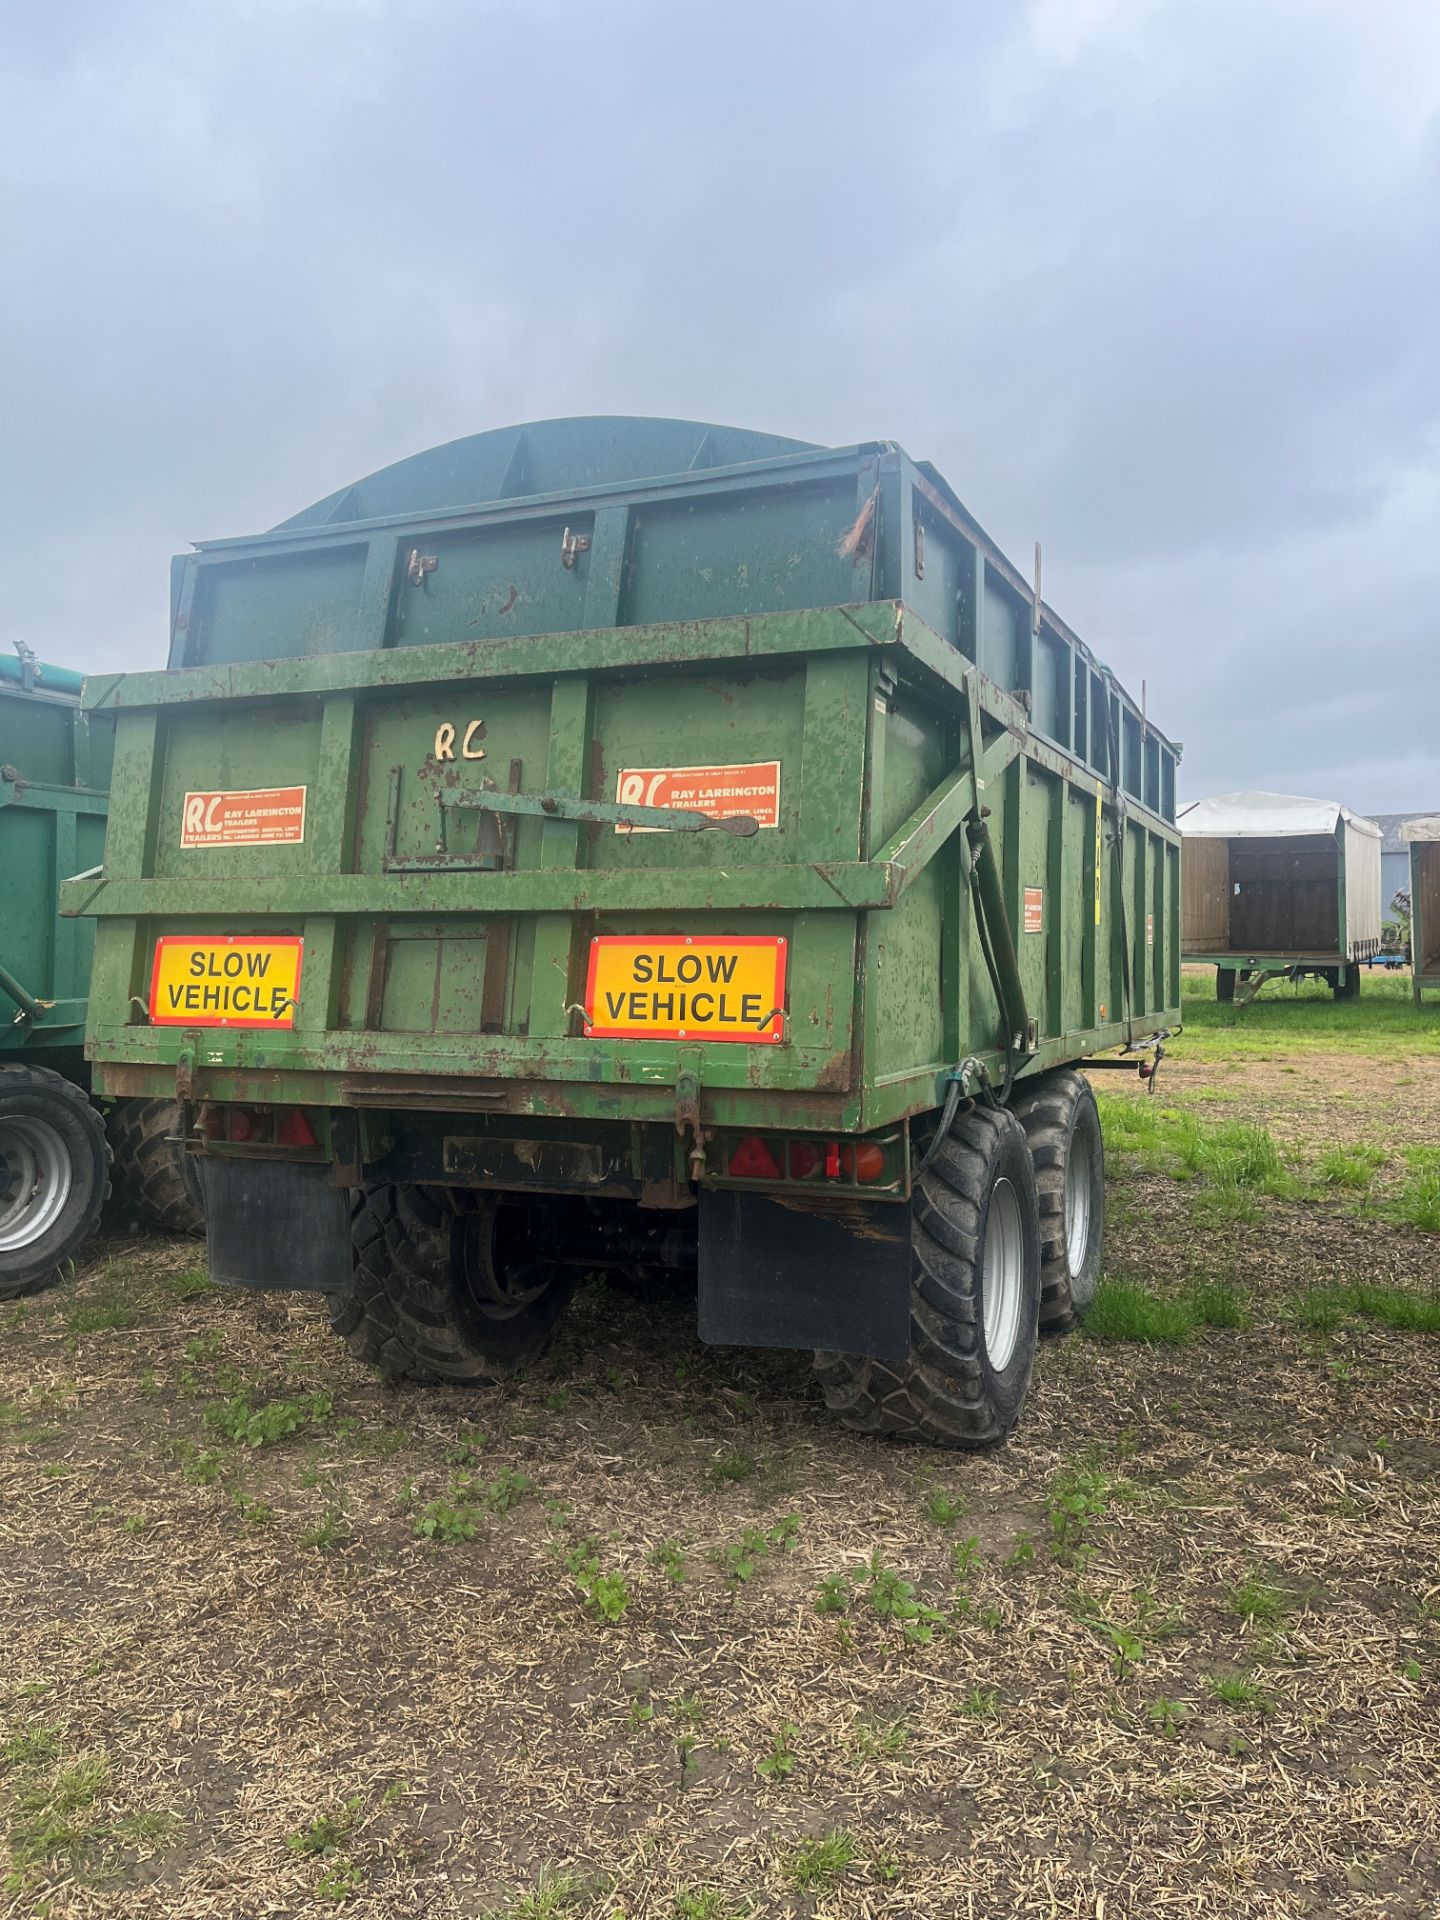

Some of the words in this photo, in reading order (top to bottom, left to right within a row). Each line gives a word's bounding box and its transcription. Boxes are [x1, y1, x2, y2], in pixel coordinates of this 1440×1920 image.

[435, 719, 486, 760] RC
[621, 774, 670, 809] RC
[671, 789, 695, 800] RAY
[698, 785, 775, 799] LARRINGTON
[672, 799, 717, 809] TRAILERS
[186, 797, 223, 833] RC
[223, 818, 258, 827] TRAILERS
[224, 810, 242, 819] RAY
[245, 806, 302, 818] LARRINGTON
[185, 833, 222, 842] TRAILERS
[189, 951, 272, 978] SLOW
[632, 954, 739, 984] SLOW
[168, 984, 288, 1013] VEHICLE
[605, 991, 762, 1023] VEHICLE
